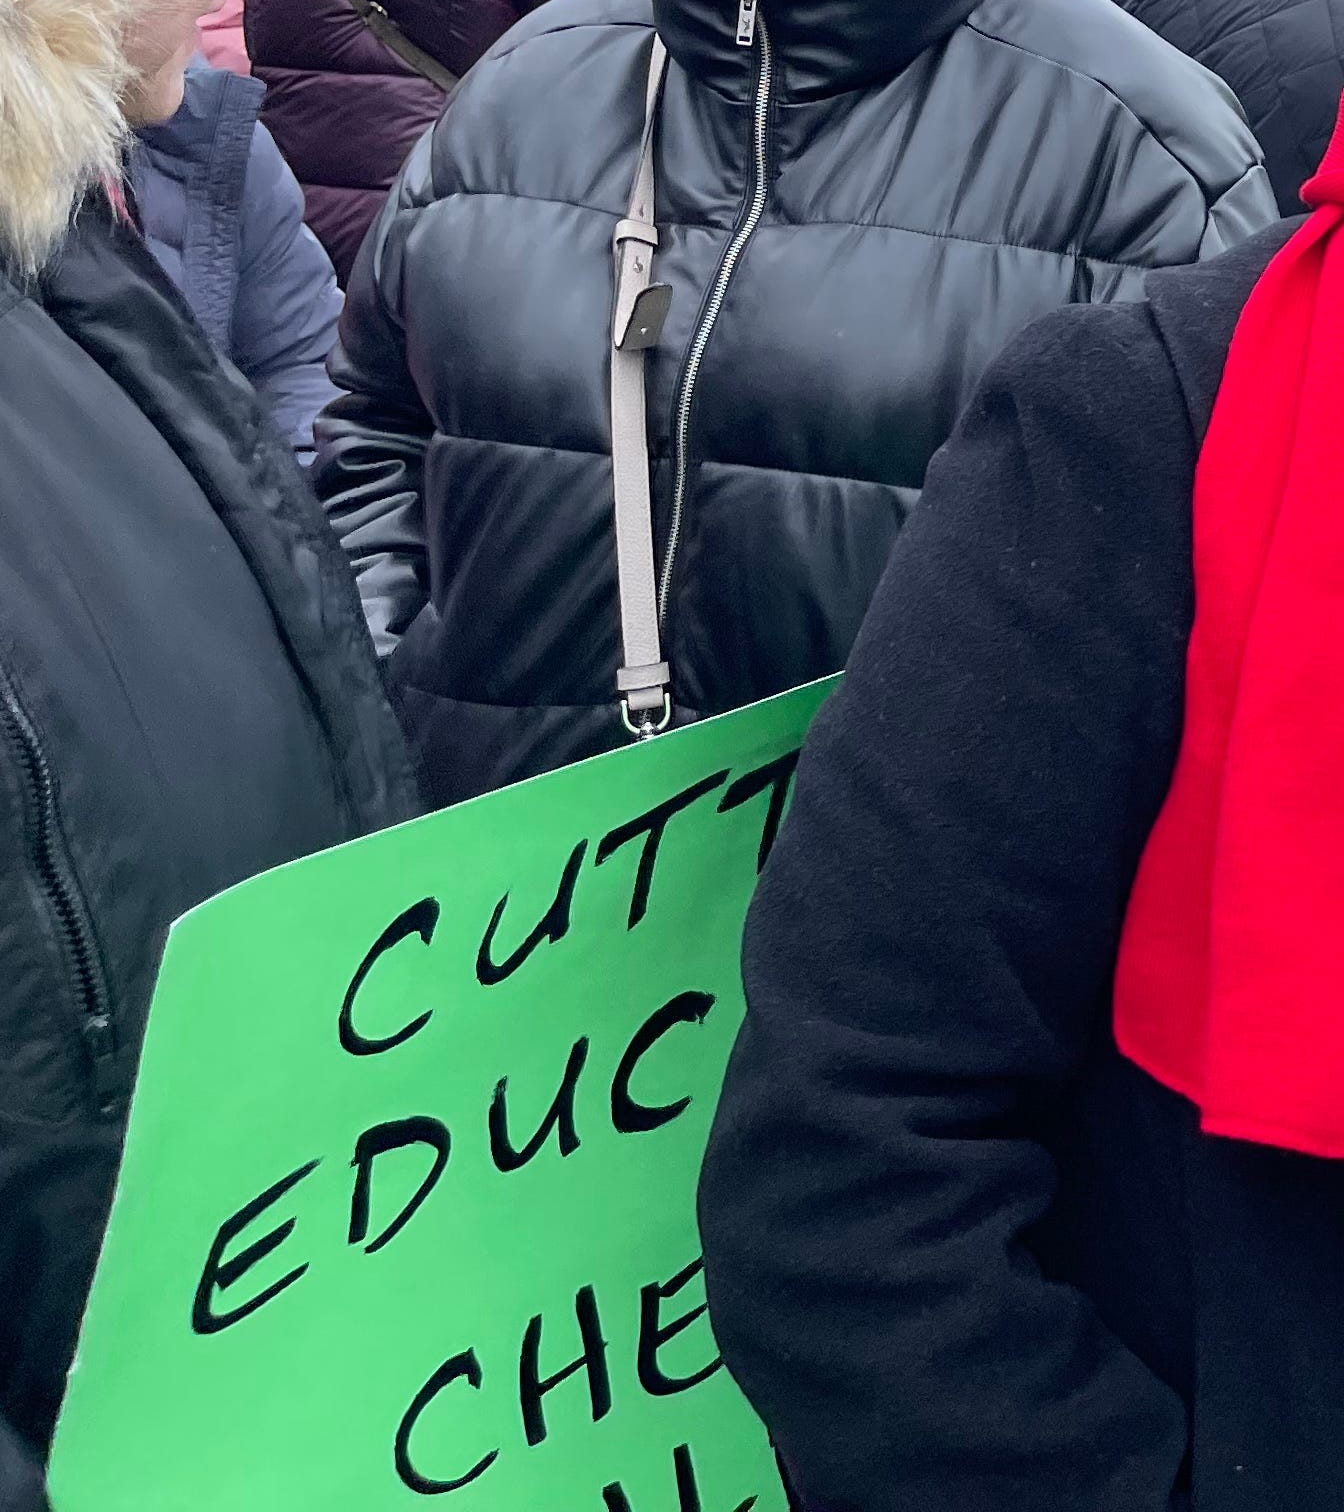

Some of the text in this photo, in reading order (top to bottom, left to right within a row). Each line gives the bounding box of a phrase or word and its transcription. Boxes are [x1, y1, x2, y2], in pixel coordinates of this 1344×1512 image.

[338, 746, 801, 1057] CUTT
[191, 990, 718, 1335] EDUC
[394, 1255, 726, 1495] CHE
